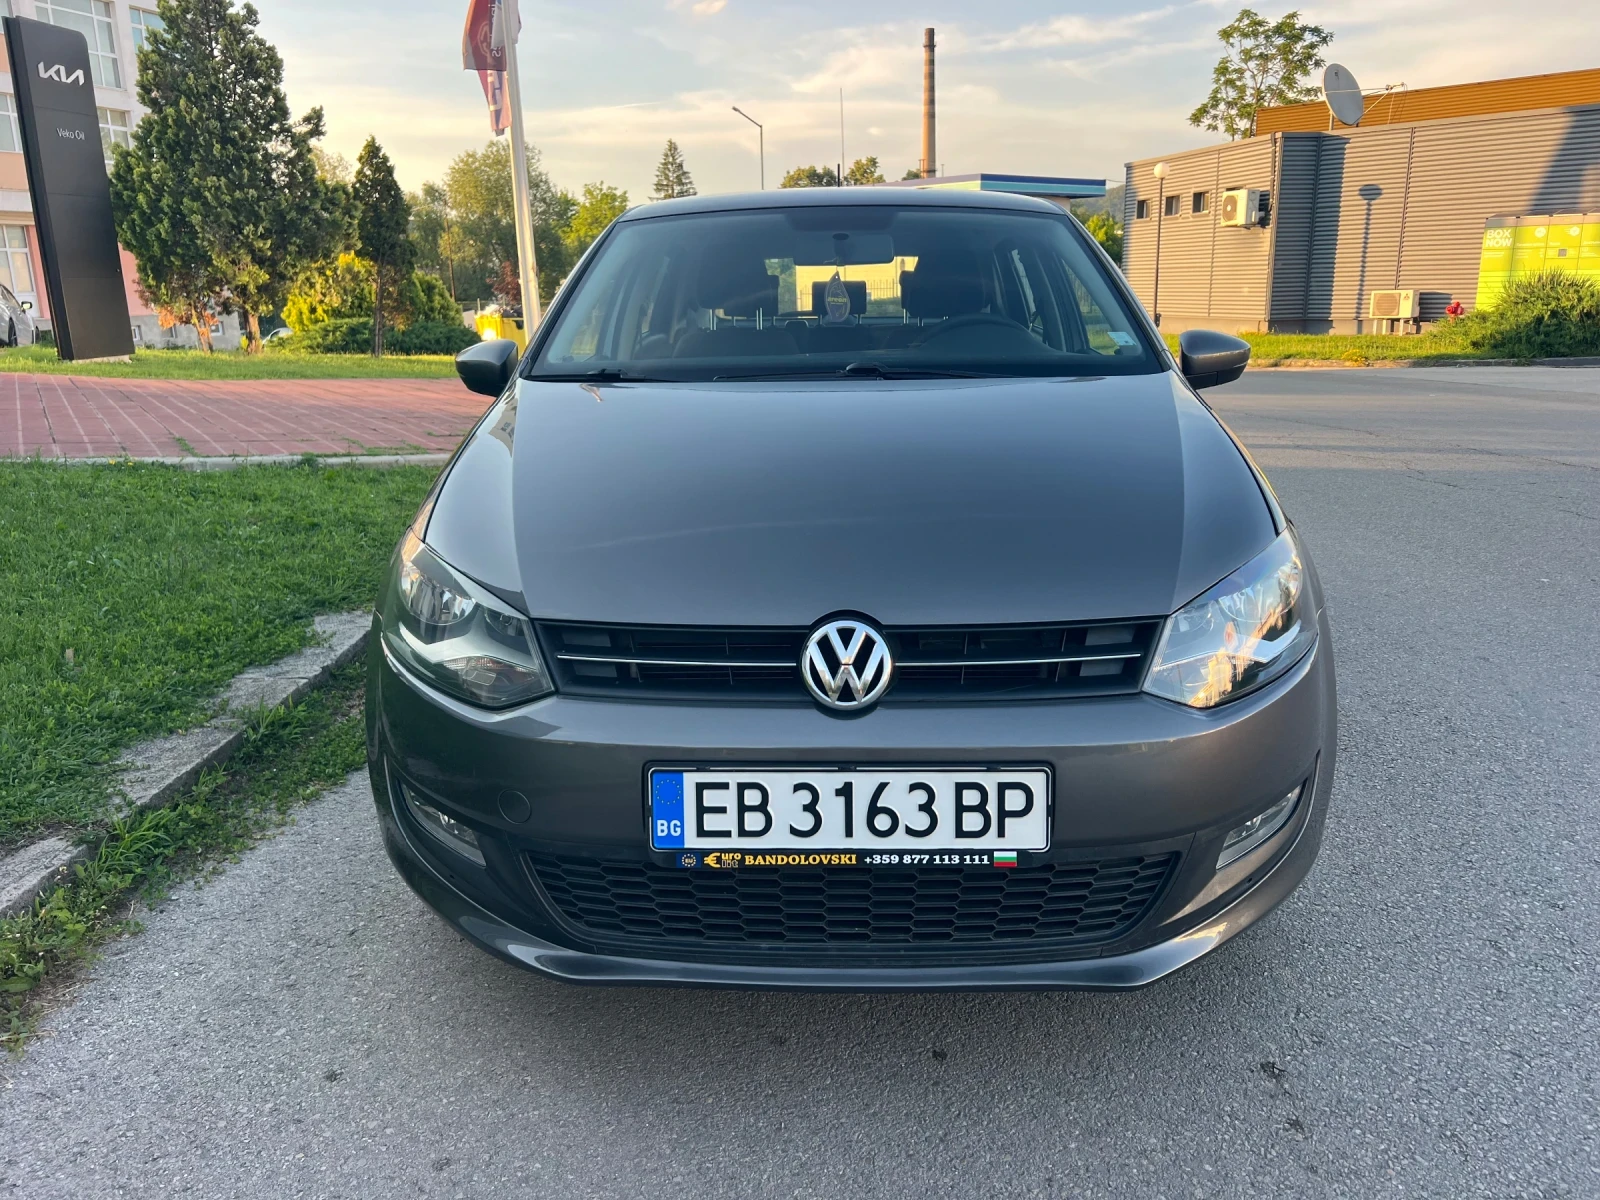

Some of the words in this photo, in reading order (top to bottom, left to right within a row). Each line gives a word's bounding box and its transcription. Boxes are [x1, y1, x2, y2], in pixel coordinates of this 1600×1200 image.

[57, 128, 74, 140] Veko
[75, 130, 85, 140] Oil
[1486, 229, 1511, 239] BOX
[1485, 238, 1512, 248] NOW
[695, 781, 774, 838] EB
[789, 781, 939, 838] 3163
[954, 782, 1034, 838] BP
[656, 820, 682, 837] BG
[745, 854, 857, 865] BANDOLOVSKI
[864, 854, 899, 865] +359
[903, 854, 930, 865] 877
[933, 854, 960, 865] 113
[963, 854, 990, 865] 111
